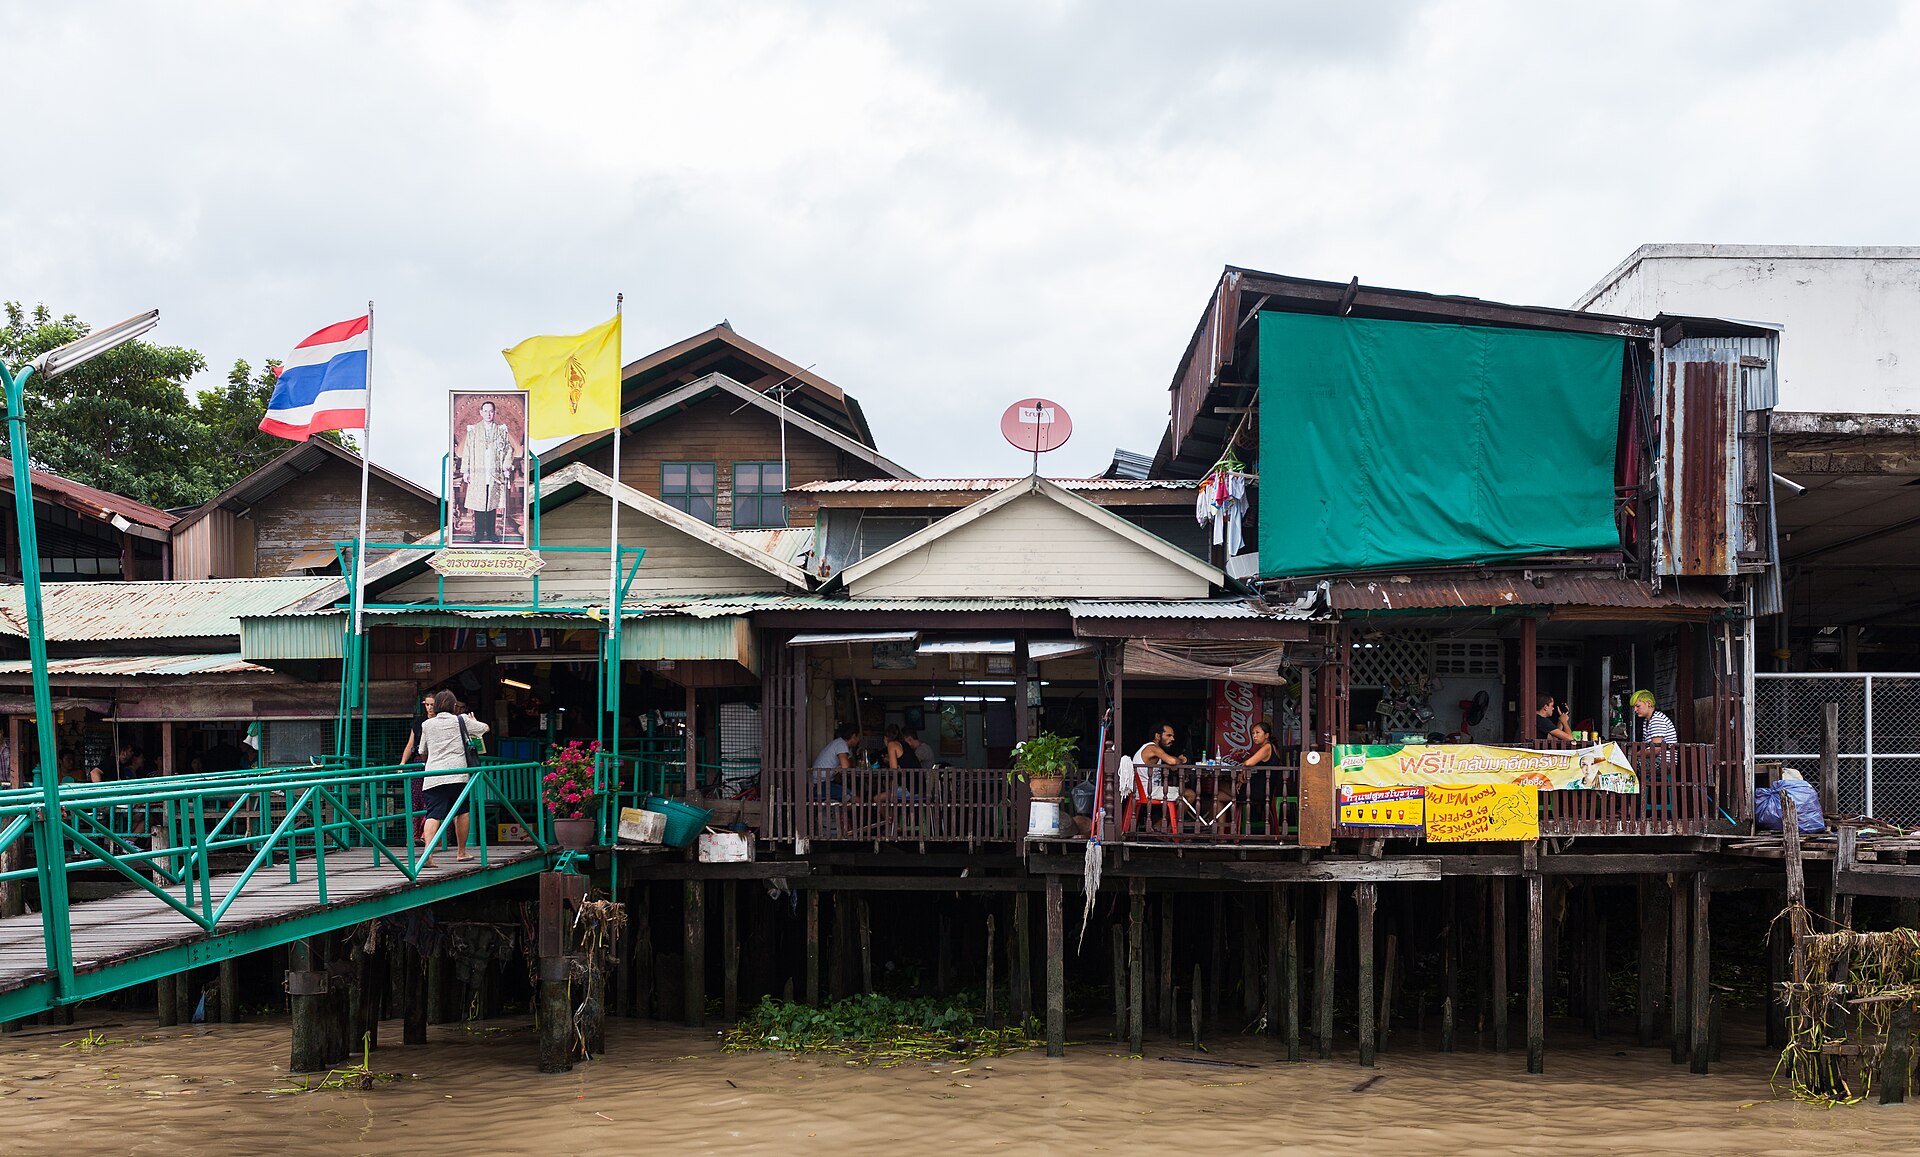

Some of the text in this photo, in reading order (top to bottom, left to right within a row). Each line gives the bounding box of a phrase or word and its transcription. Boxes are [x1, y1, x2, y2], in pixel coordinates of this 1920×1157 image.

[446, 556, 527, 571] ทรงพระเจริญ
[1223, 680, 1253, 750] Coca-Col
[1457, 753, 1569, 771] กลับมาอีกครัง!!
[1447, 793, 1469, 806] WAT
[1428, 809, 1473, 823] EXPERT
[1430, 815, 1488, 834] COMPRESS
